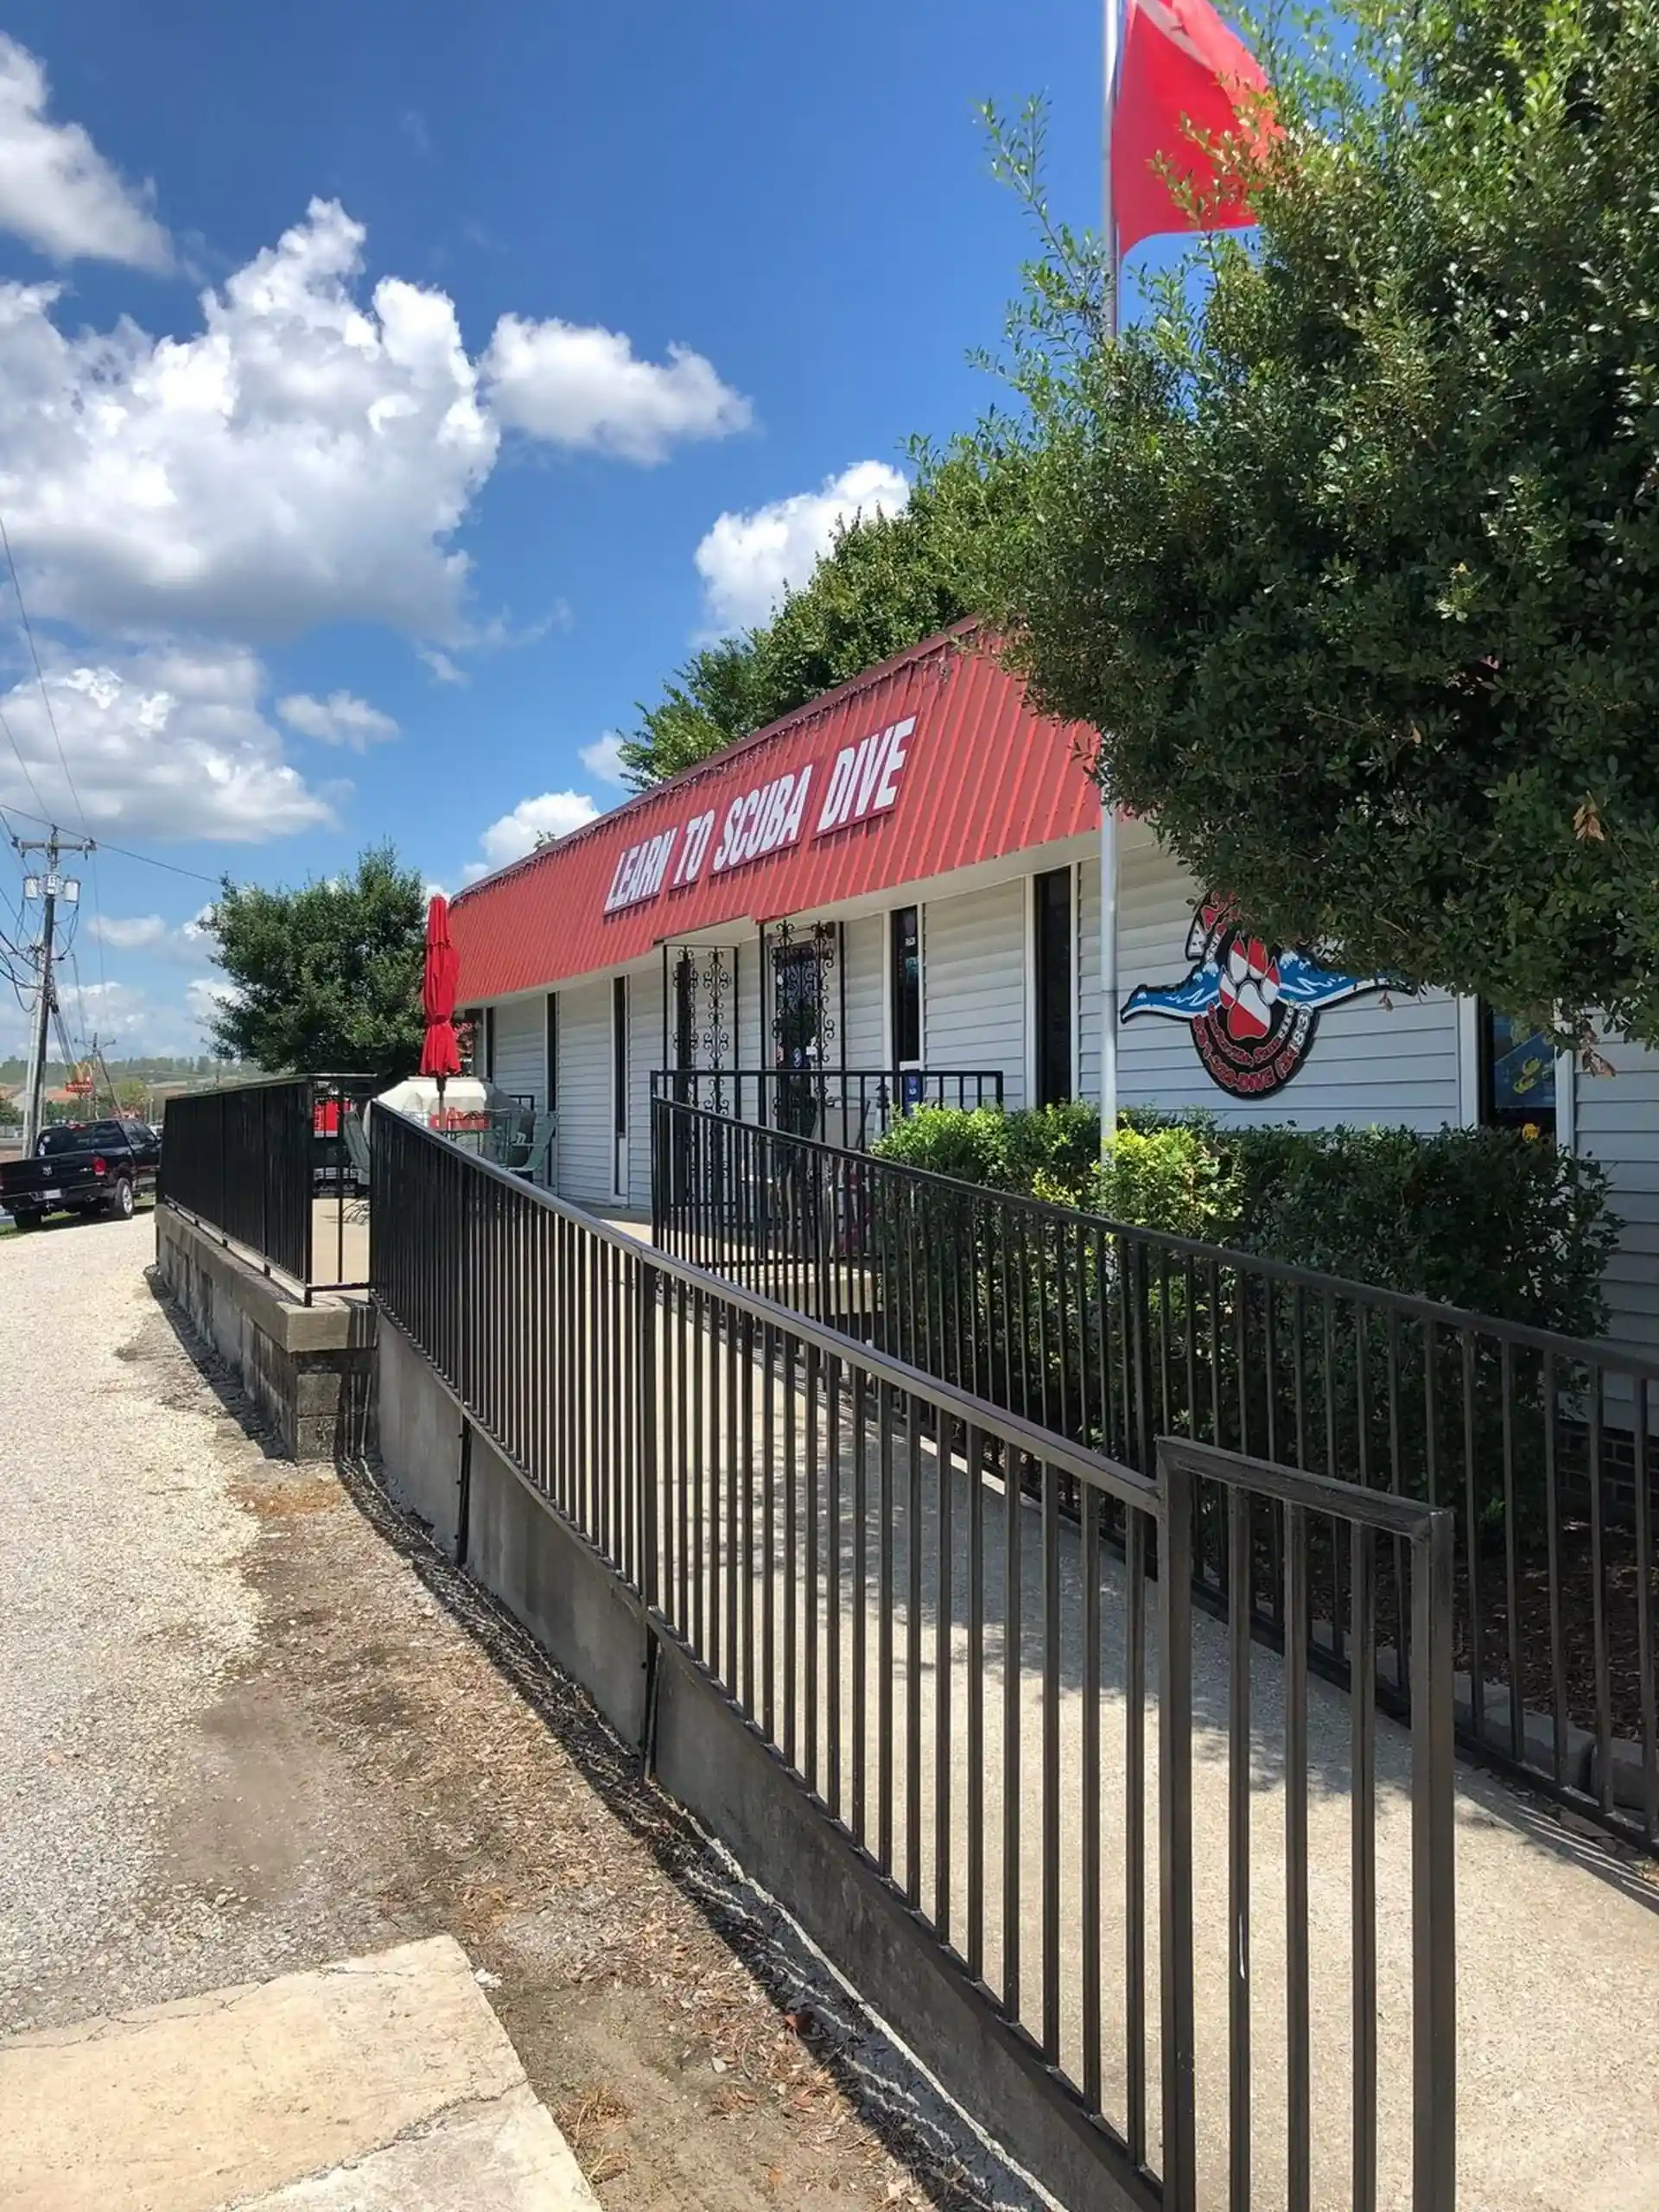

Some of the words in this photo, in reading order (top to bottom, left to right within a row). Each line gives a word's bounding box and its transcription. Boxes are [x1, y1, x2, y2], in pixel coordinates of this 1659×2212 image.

[604, 826, 677, 912] LEARN
[673, 809, 715, 886] TO
[715, 763, 813, 872] SCUBA
[817, 715, 916, 833] DIVE
